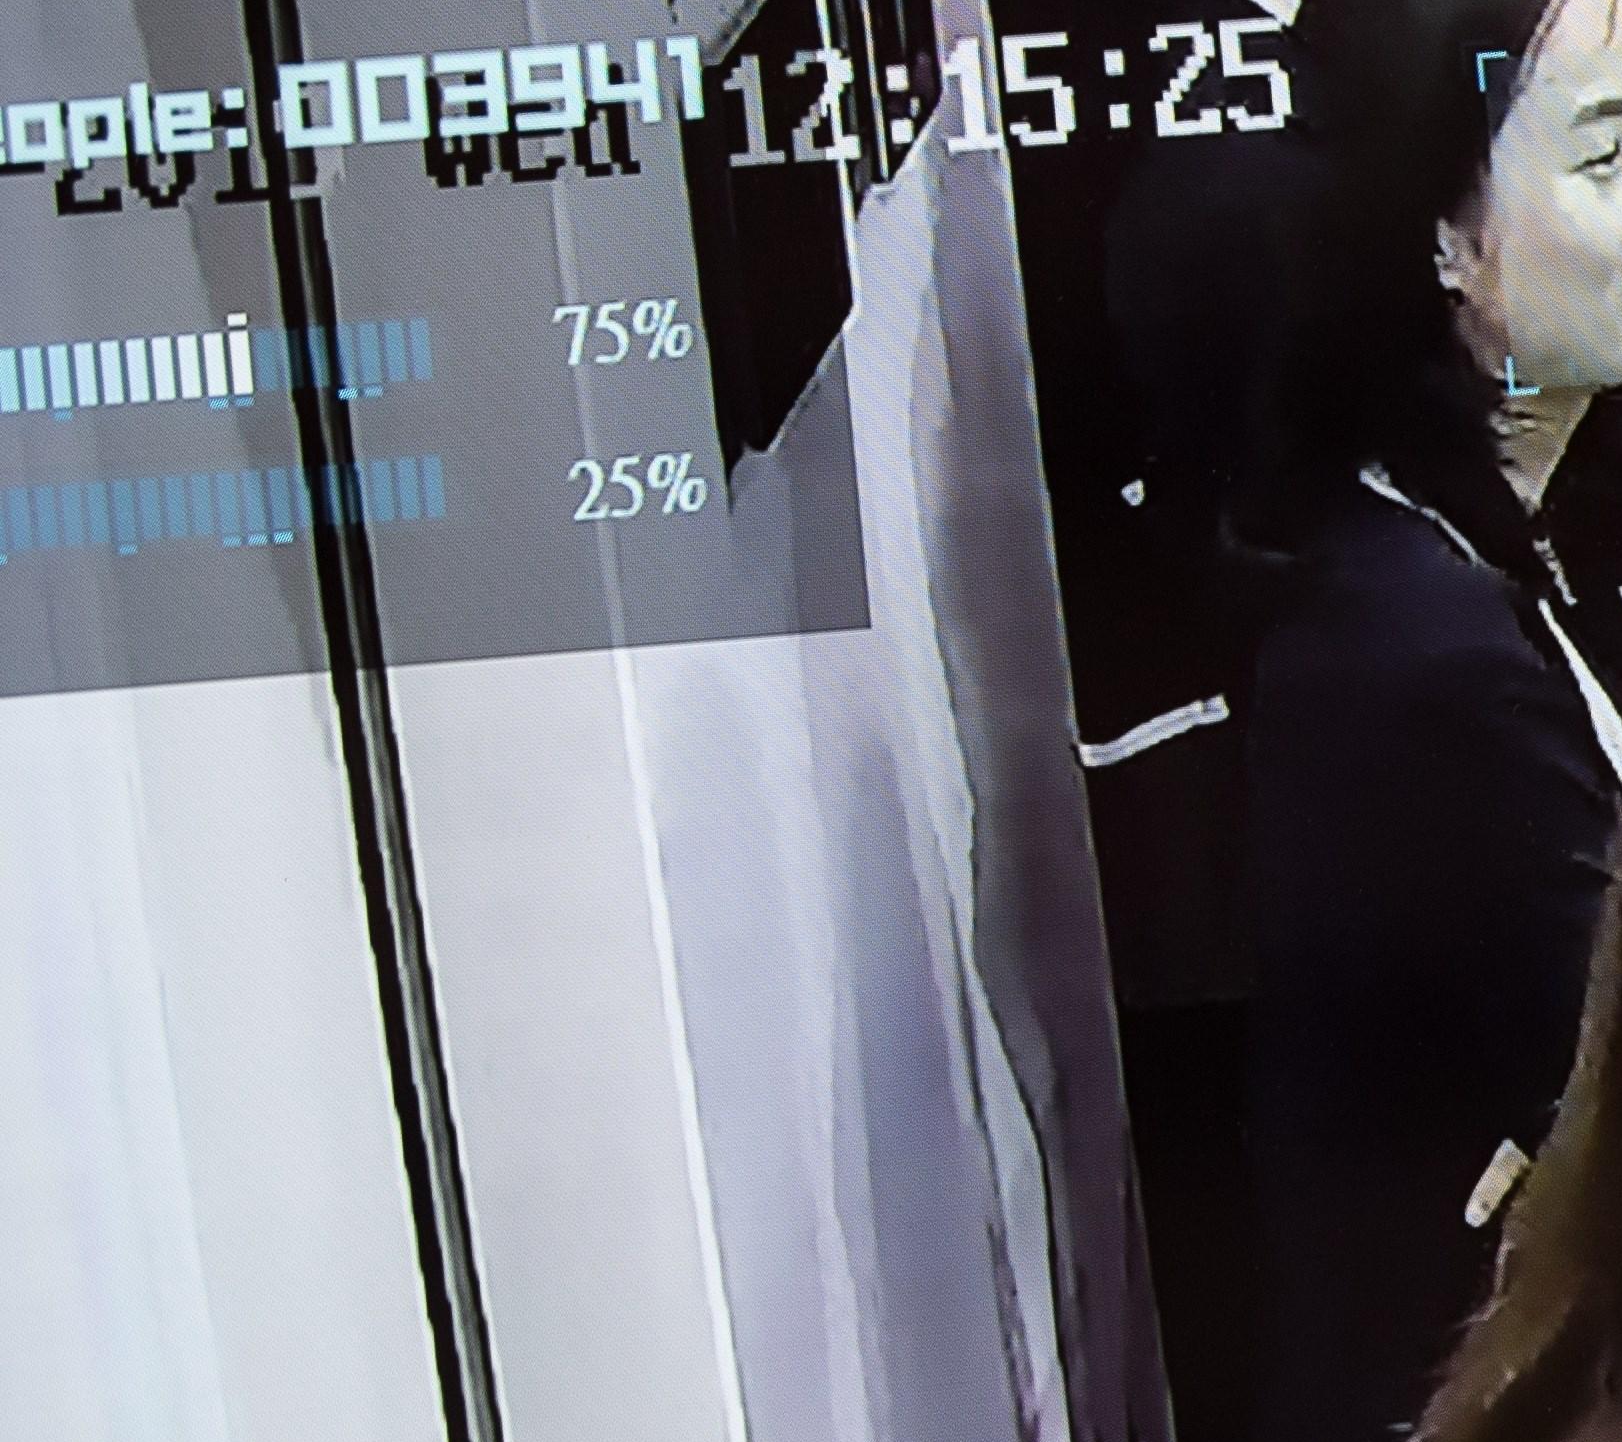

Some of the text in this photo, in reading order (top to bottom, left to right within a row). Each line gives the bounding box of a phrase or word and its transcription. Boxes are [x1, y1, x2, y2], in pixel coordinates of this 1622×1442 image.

[0, 82, 248, 169] ople:
[554, 299, 693, 364] 75%
[568, 454, 708, 521] 25%
